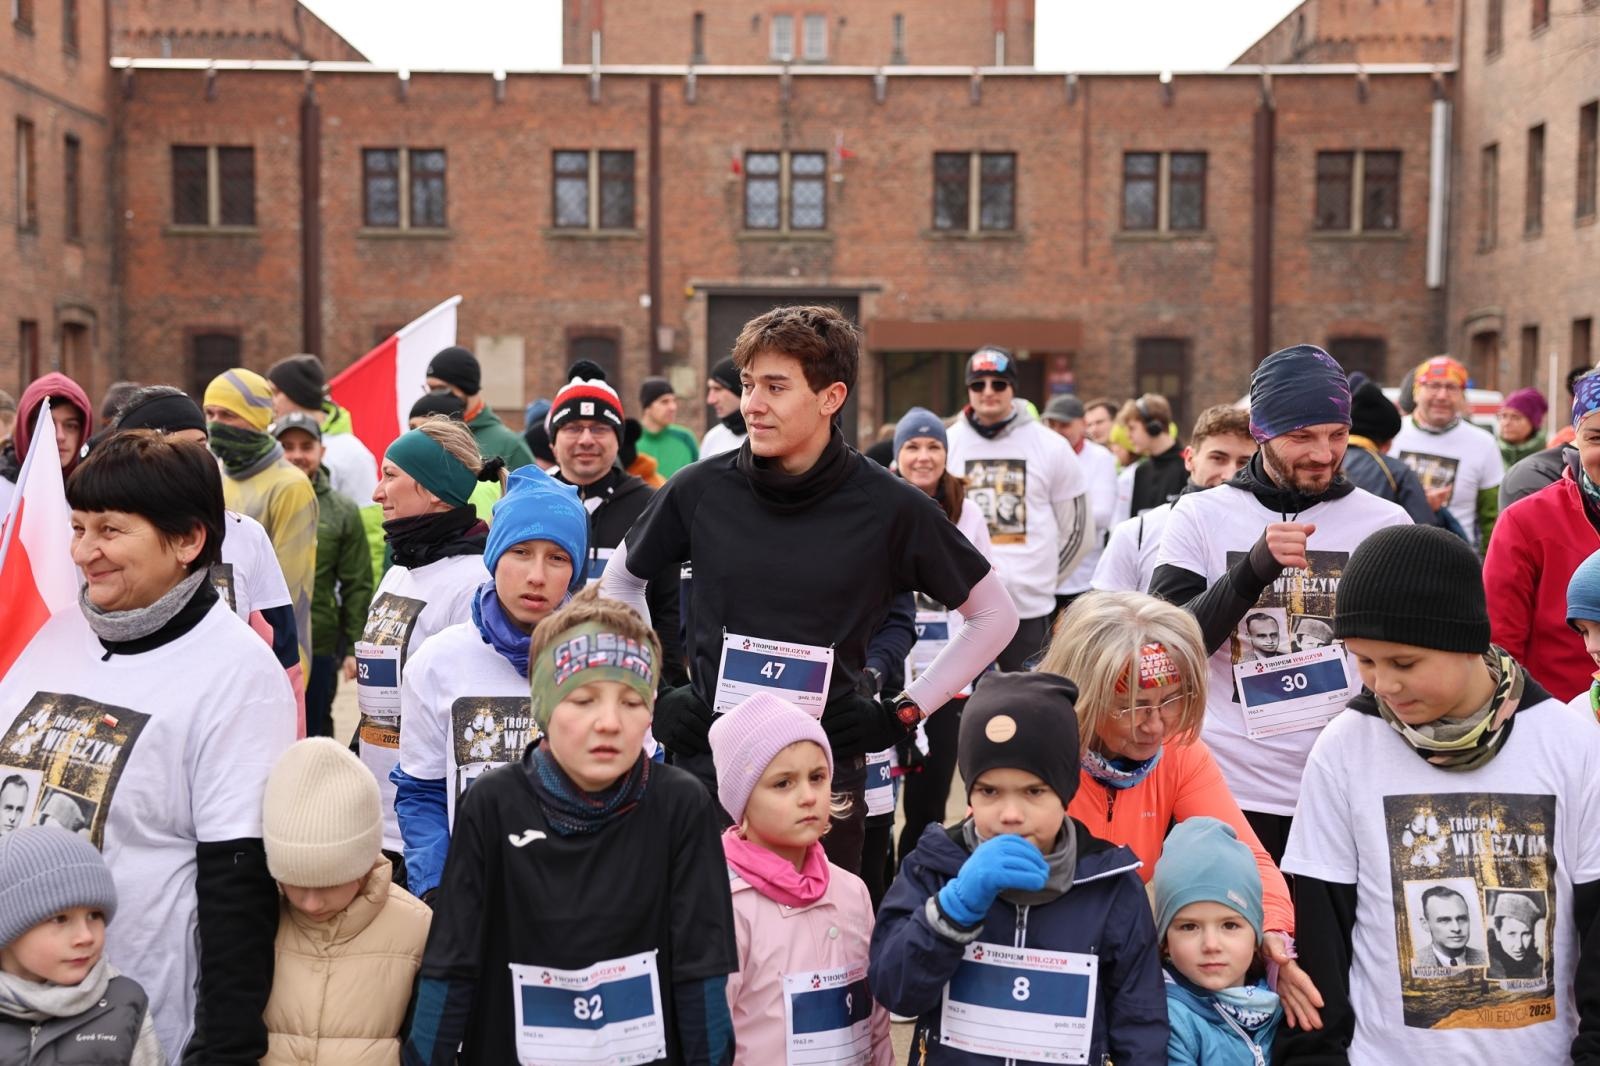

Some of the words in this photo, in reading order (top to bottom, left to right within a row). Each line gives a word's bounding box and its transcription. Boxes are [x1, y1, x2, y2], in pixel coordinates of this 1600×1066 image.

[752, 642, 778, 651] TROPEM
[779, 646, 811, 656] WILCZYM
[1265, 659, 1292, 669] TROPEM
[1292, 652, 1323, 663] WILCZYM
[358, 663, 370, 679] 52
[760, 661, 786, 680] 47
[1281, 673, 1308, 692] 30
[53, 714, 96, 738] TROPEM
[503, 716, 539, 729] TROPE
[42, 728, 122, 765] WILCZYM
[880, 765, 891, 781] 90
[1450, 817, 1498, 832] TROPEM
[1452, 833, 1547, 856] WILCZYM
[987, 950, 1024, 961] TROPEM
[1026, 955, 1068, 965] WILCZYM
[554, 975, 589, 984] TROPEM
[590, 965, 626, 981] WILCZYM
[1012, 976, 1031, 1001] 8
[574, 994, 604, 1021] 82
[1529, 1003, 1552, 1018] 2025
